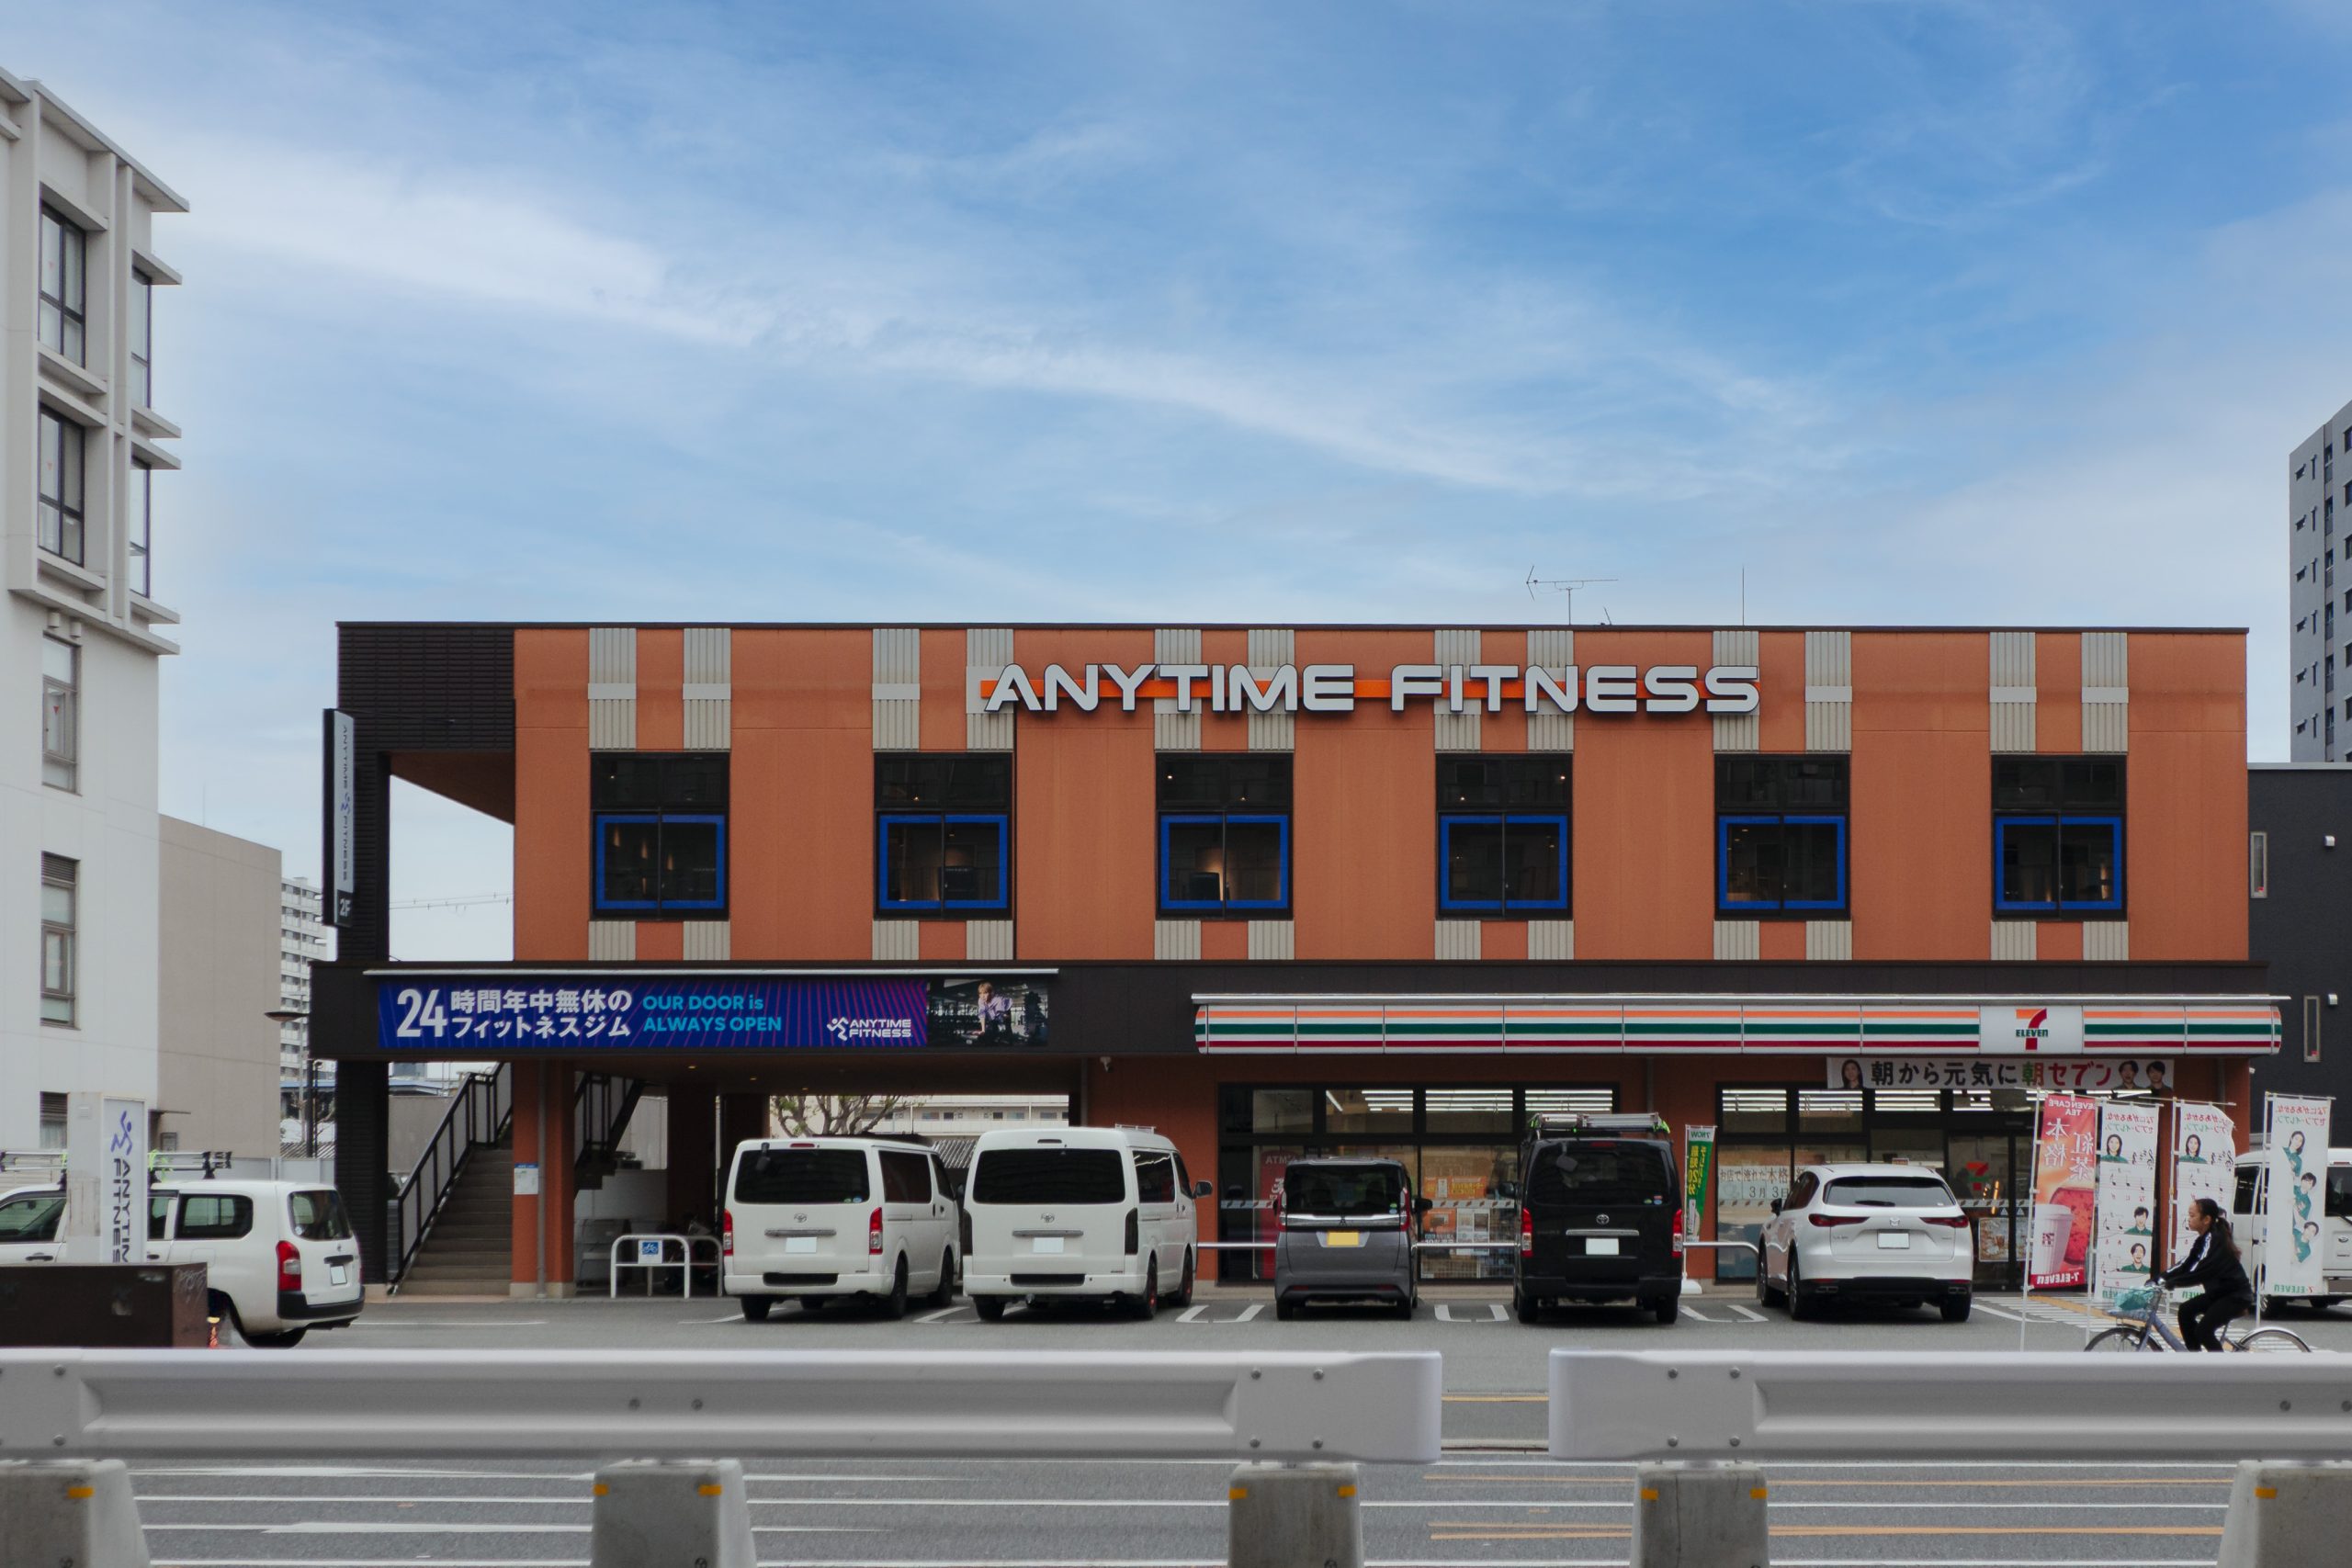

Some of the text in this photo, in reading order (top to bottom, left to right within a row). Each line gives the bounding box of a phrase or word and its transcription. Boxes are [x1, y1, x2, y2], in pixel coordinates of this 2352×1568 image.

[984, 663, 1760, 713] ANYTIME FITNESS
[339, 898, 351, 917] 2F
[396, 988, 447, 1038] 24
[450, 989, 633, 1014] 時間年中無休の
[643, 995, 763, 1010] OUR DOOR is
[451, 1016, 631, 1039] フィットネスジム
[643, 1017, 782, 1032] ALWAYS OPEN
[849, 1029, 911, 1038] FITNESS
[850, 1019, 911, 1028] ANYTIME
[1871, 1060, 2111, 1086] 朝から元気に朝セブン
[113, 1158, 121, 1263] FITNES
[122, 1159, 130, 1262] ANYTIM
